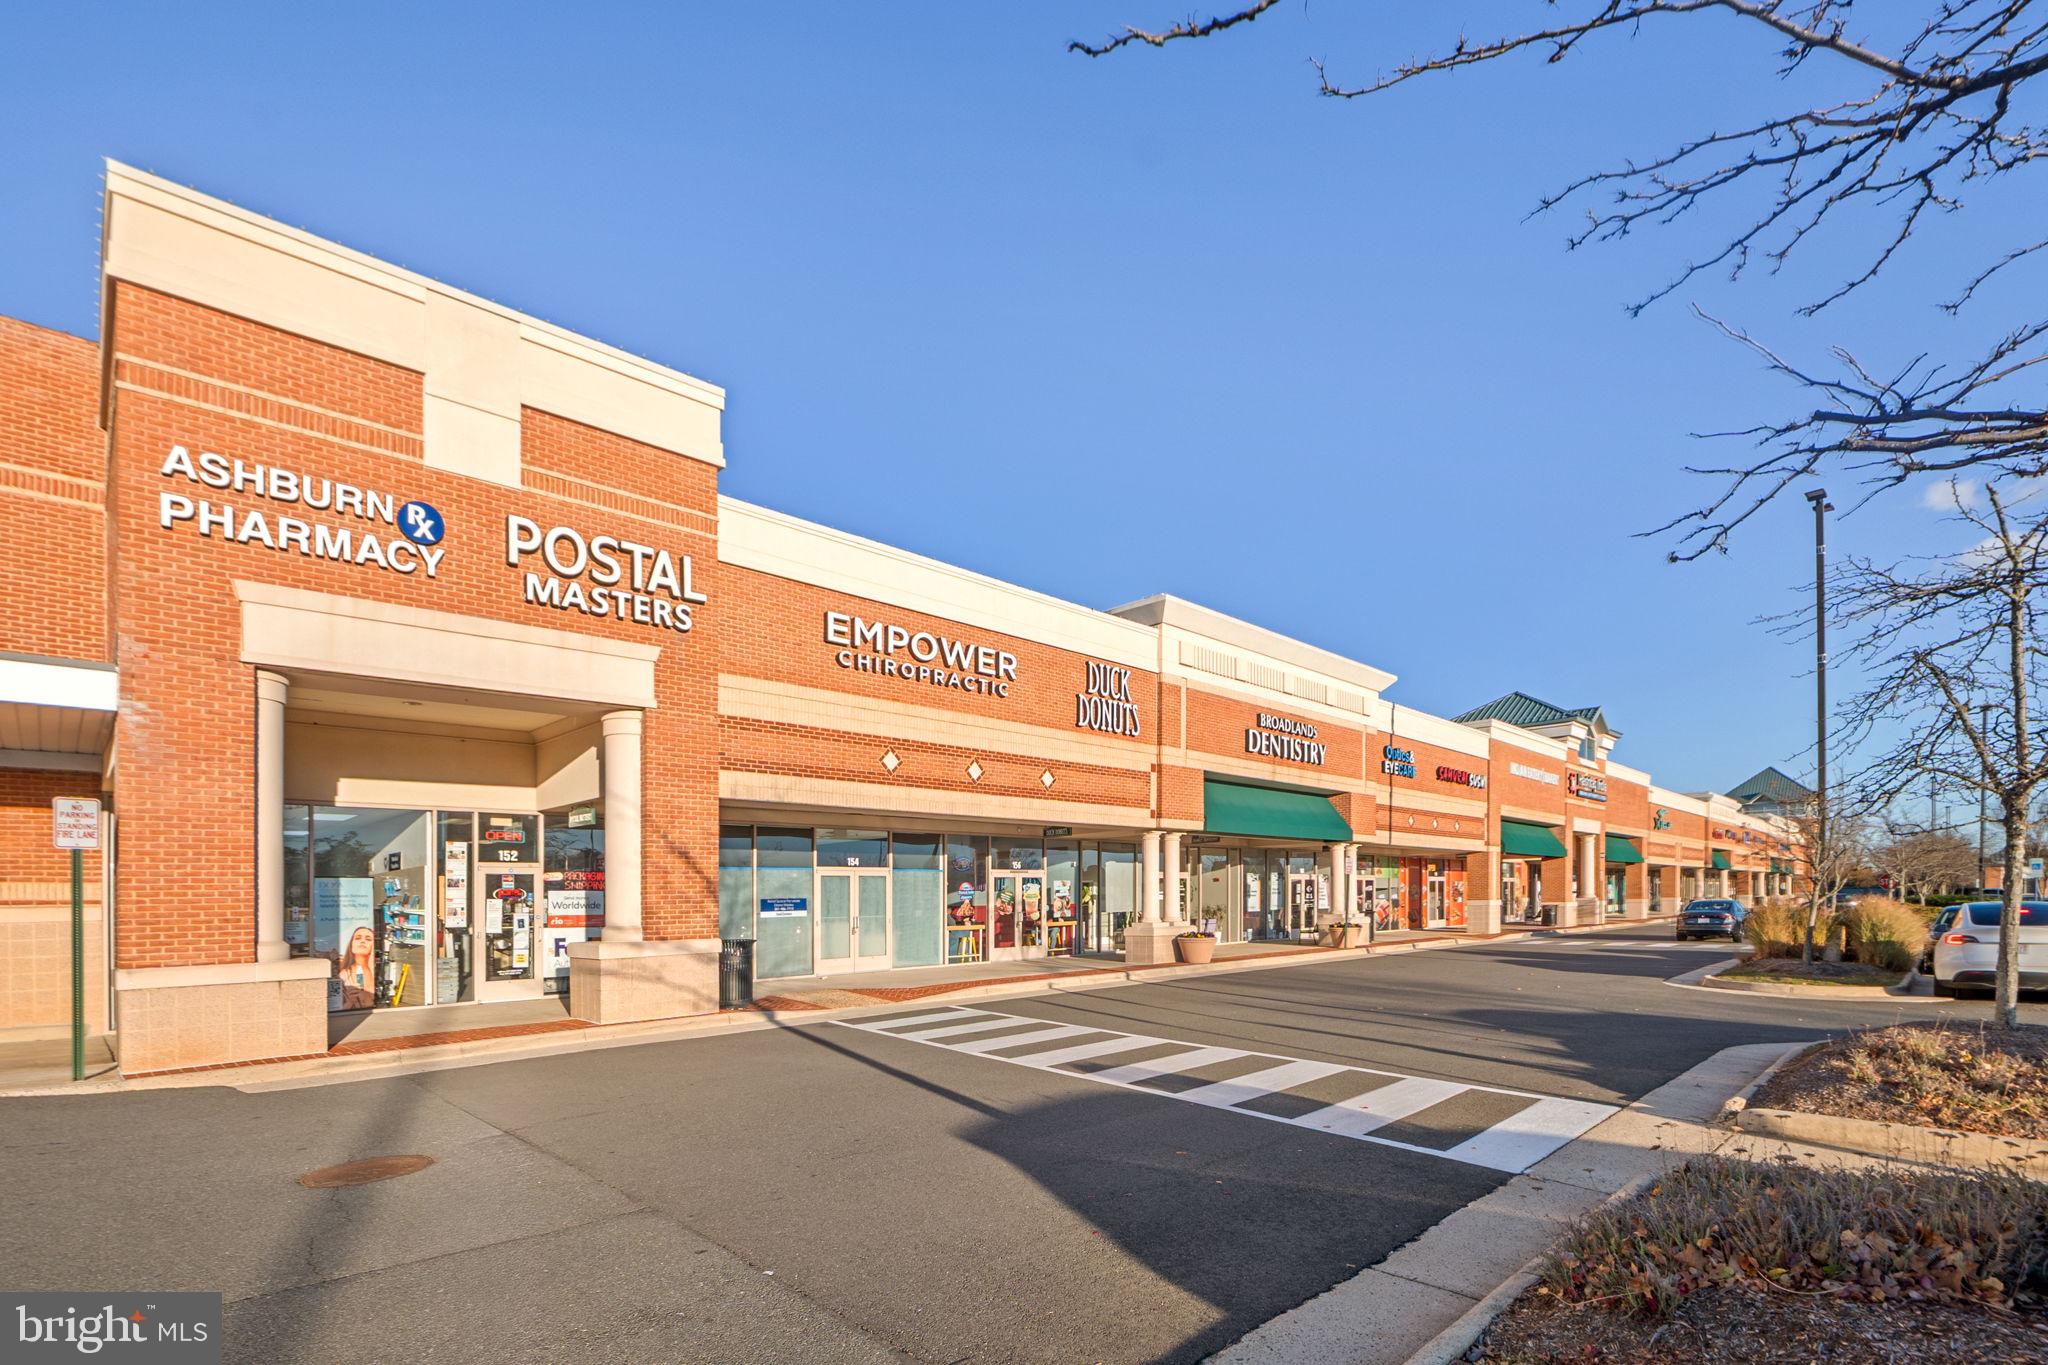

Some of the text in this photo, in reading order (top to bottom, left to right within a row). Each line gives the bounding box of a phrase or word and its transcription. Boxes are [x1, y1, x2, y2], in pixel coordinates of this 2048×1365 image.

[161, 445, 395, 525] ASHBURN
[159, 492, 446, 578] PHARMACY
[507, 514, 708, 604] POSTAL
[525, 572, 694, 633] MASTERS
[824, 611, 1018, 680] EMPOWER
[836, 650, 1010, 698] CHIROPRACTIC
[1085, 661, 1132, 701] DUCK
[1076, 693, 1141, 737] DONUTS
[1258, 713, 1318, 739] BROADLANDS
[1246, 729, 1327, 766] DENTISTRY
[57, 822, 98, 830] STANDING
[60, 811, 95, 819] PARKING
[57, 830, 98, 839] FIRE LANE
[485, 831, 522, 842] OPEN
[497, 850, 519, 861] 152
[847, 857, 860, 867] 154
[1012, 861, 1022, 869] 156
[551, 901, 602, 910] Worldwide
